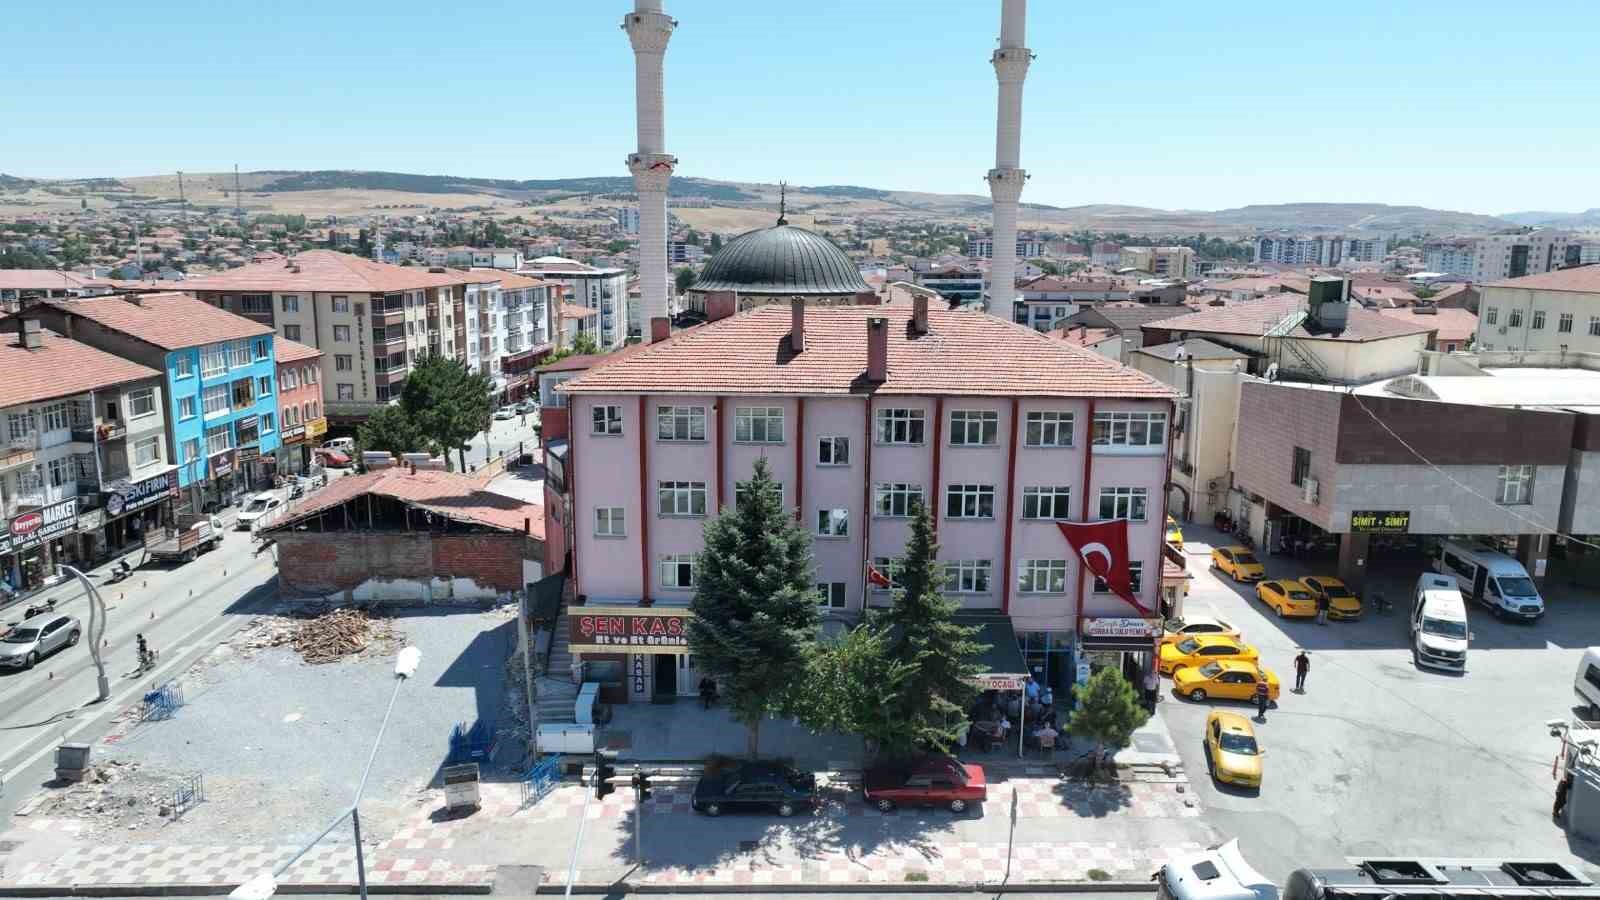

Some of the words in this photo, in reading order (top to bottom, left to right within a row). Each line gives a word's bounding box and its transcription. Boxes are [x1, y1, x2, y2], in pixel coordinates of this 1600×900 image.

[43, 500, 76, 525] MARKET
[580, 616, 625, 637] ŞEN
[632, 617, 688, 635] KAS
